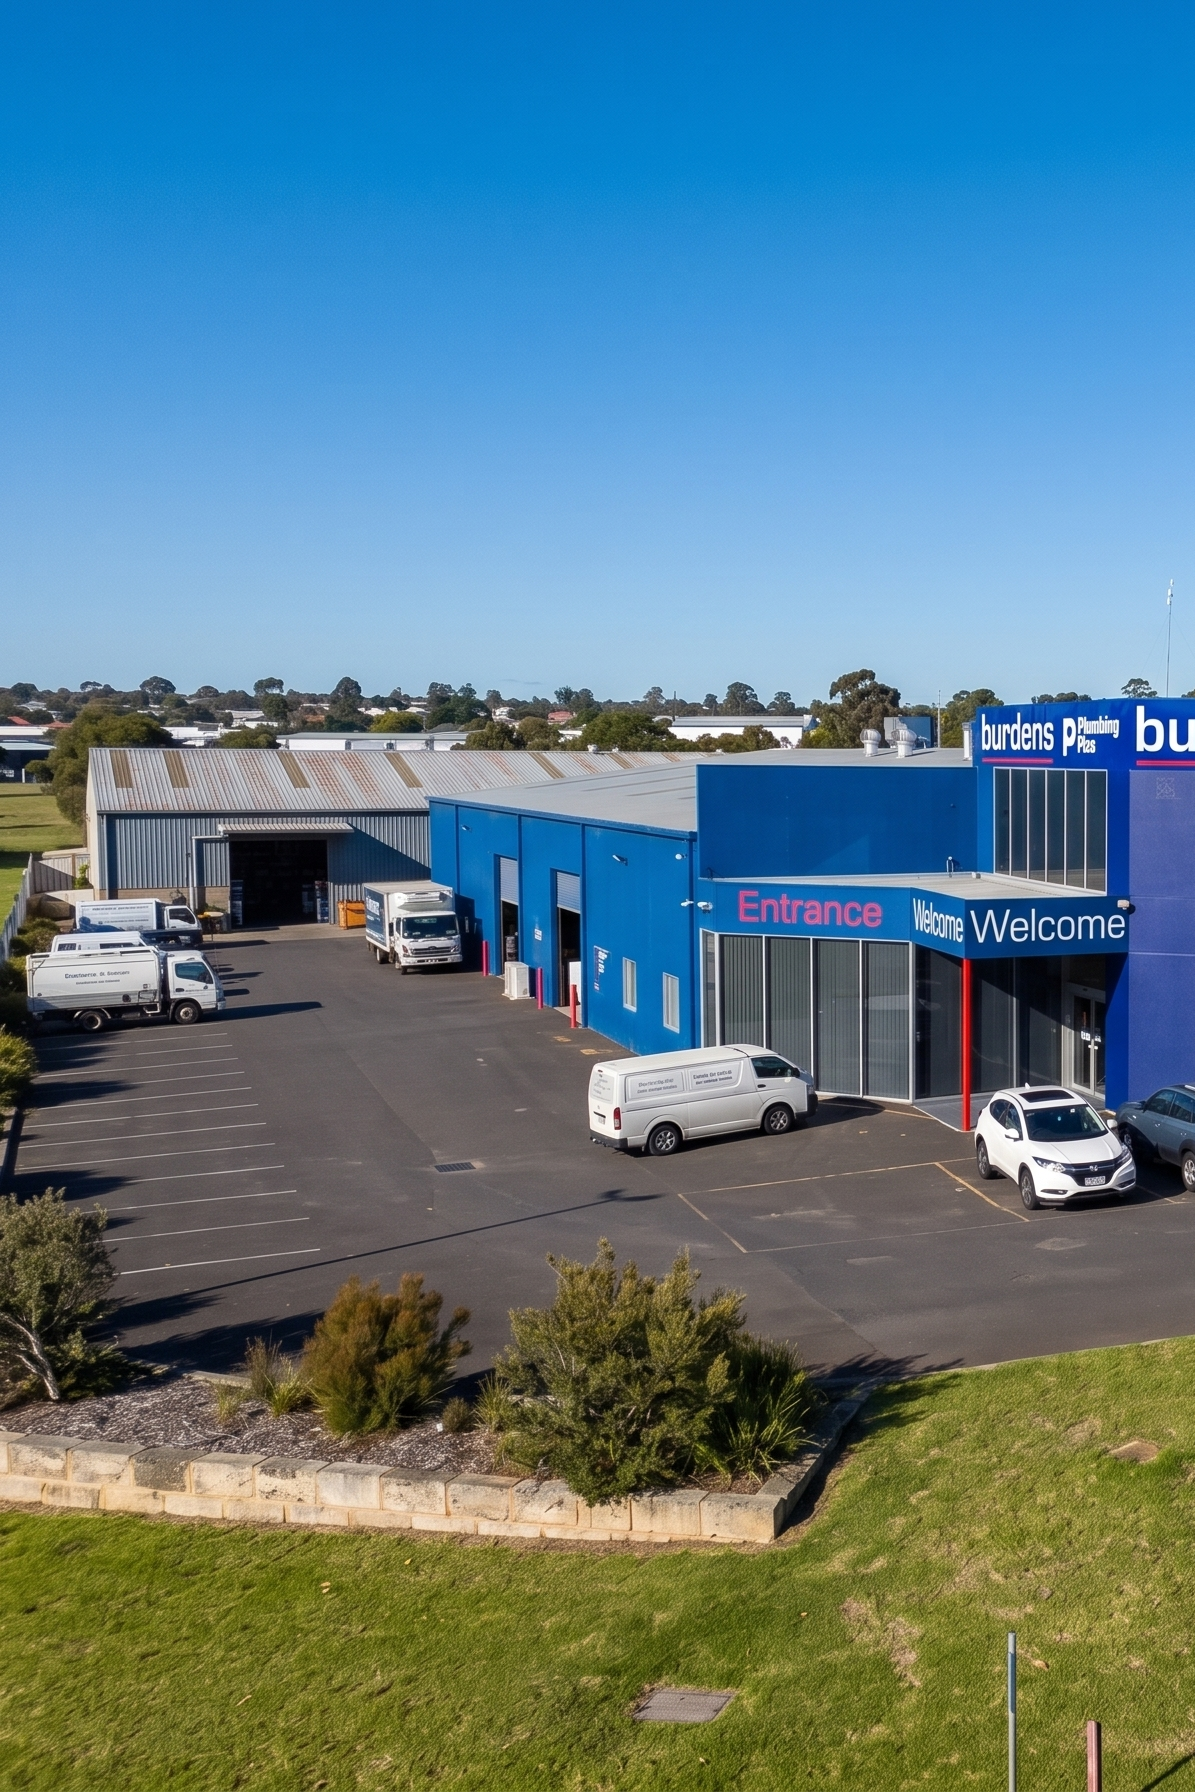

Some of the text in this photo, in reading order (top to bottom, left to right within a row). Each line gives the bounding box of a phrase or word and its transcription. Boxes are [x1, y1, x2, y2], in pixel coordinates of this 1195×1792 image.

[981, 712, 1055, 751] burdens
[1077, 715, 1120, 739] Plumbing
[738, 890, 882, 927] Entrance
[913, 898, 964, 943] Welcome
[970, 908, 1126, 943] Welcome
